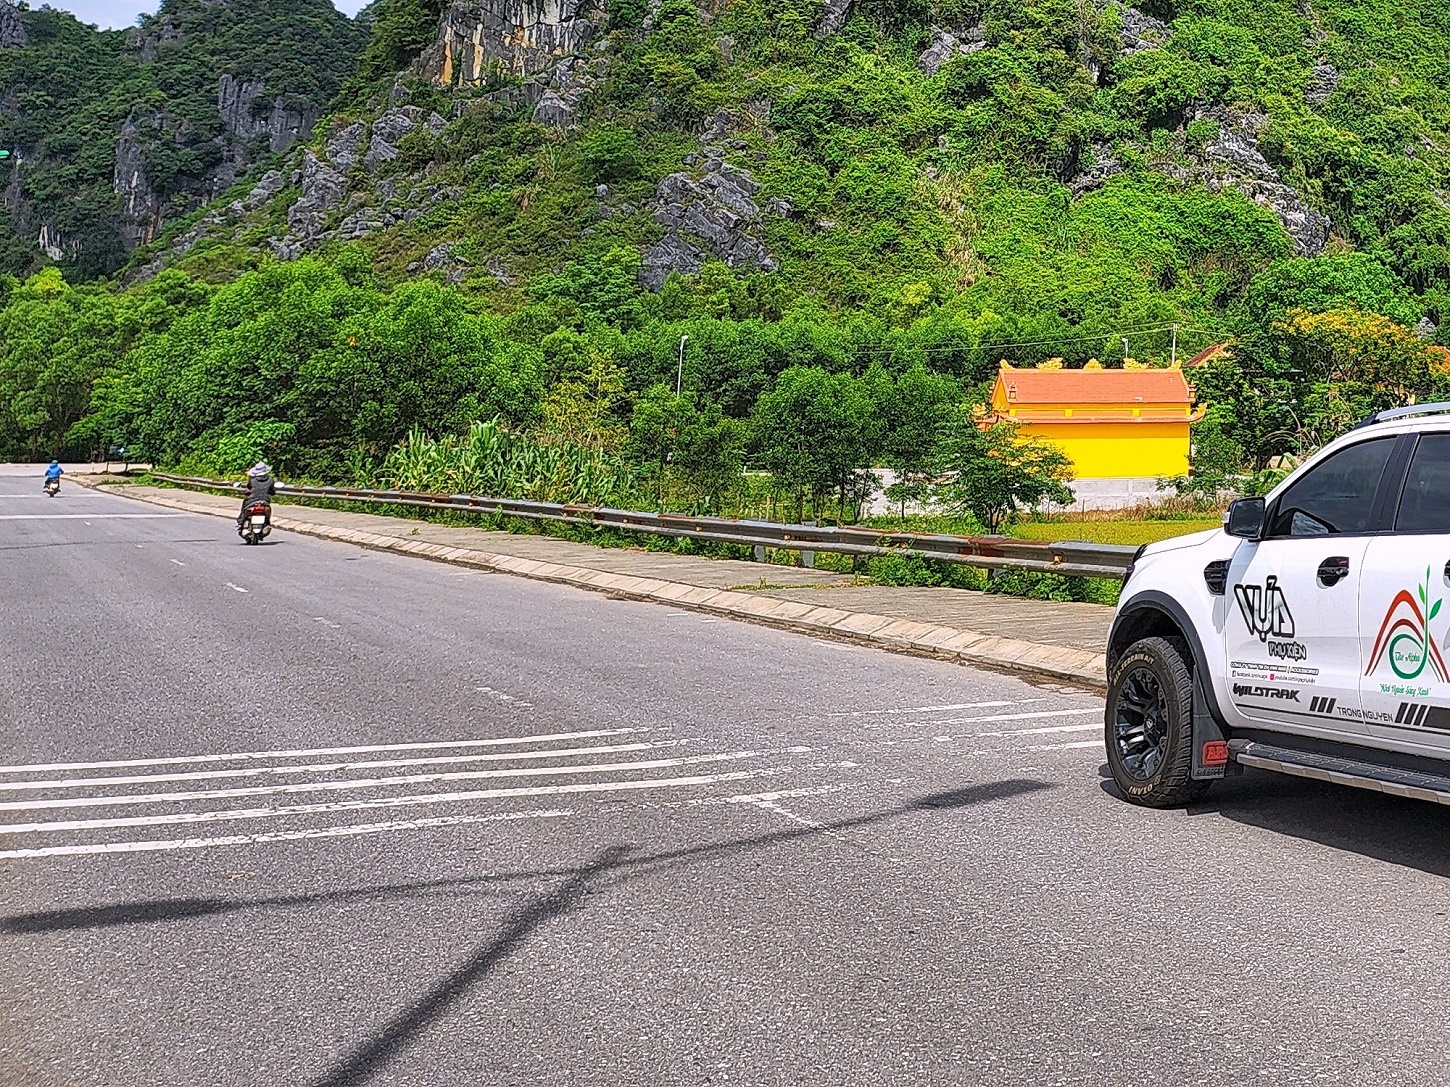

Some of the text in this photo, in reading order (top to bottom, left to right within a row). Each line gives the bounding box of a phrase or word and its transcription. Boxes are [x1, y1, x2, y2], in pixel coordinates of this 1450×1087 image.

[1232, 682, 1301, 703] WILDTRAK
[1336, 706, 1394, 723] TRONG NGUYEN
